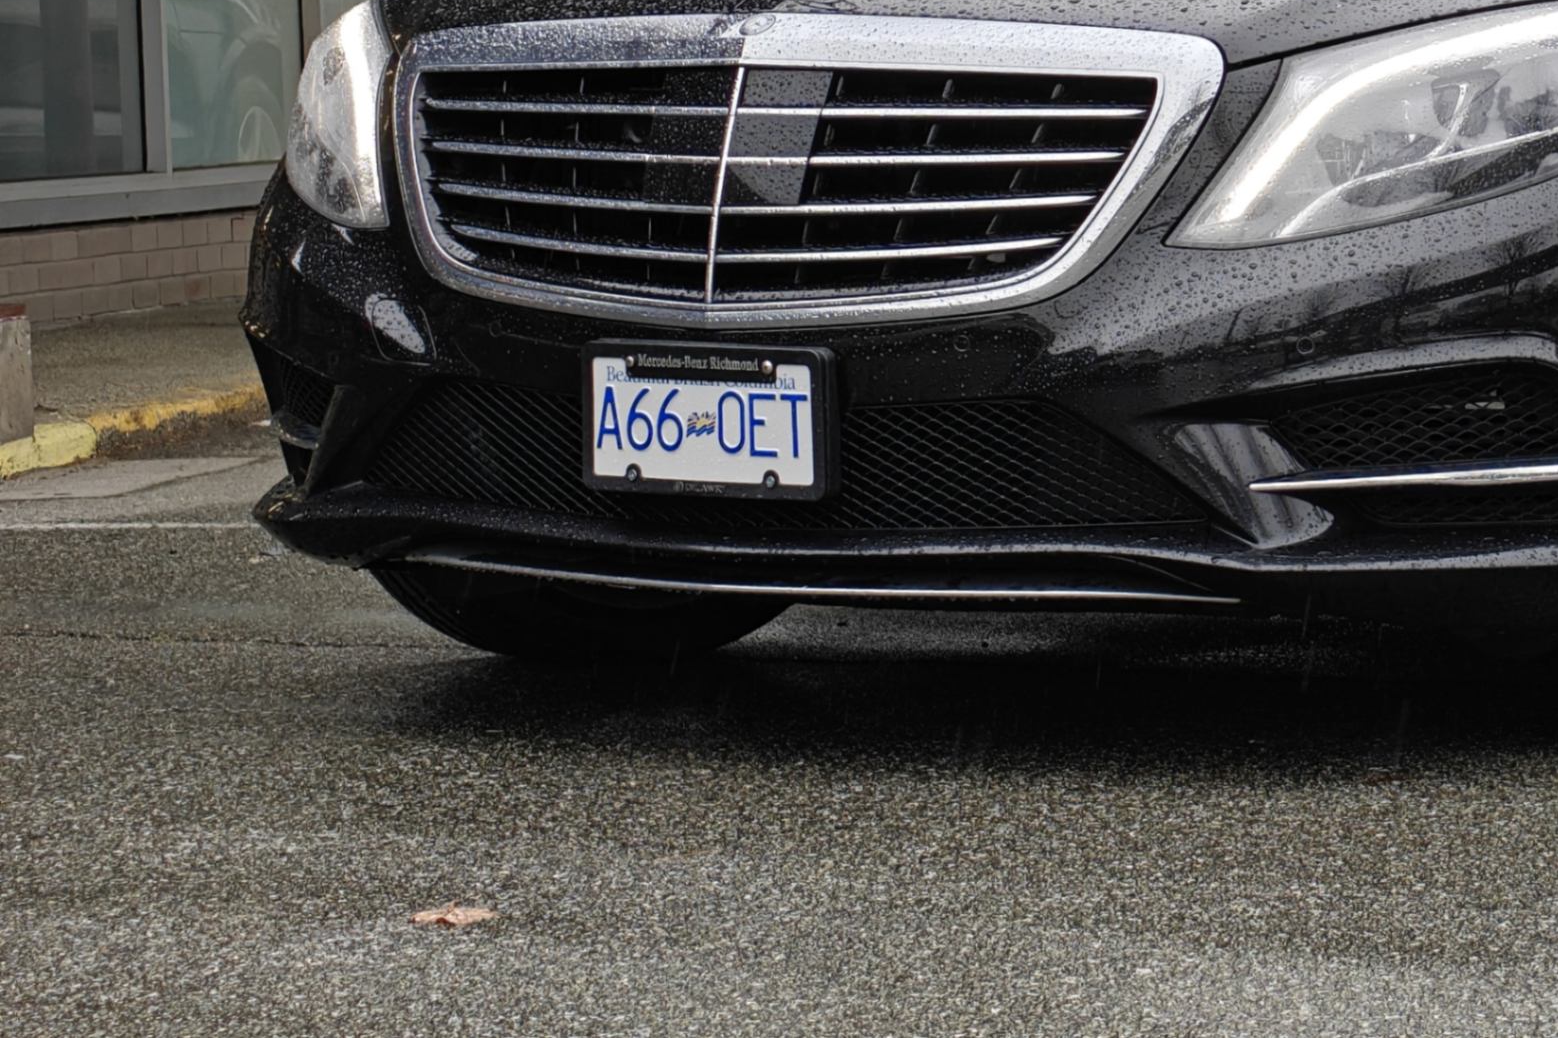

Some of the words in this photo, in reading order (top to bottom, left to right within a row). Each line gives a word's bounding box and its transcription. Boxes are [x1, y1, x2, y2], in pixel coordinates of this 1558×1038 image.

[637, 353, 708, 370] Mercedes-Benz
[709, 356, 760, 371] Richmond
[597, 385, 684, 452] A66
